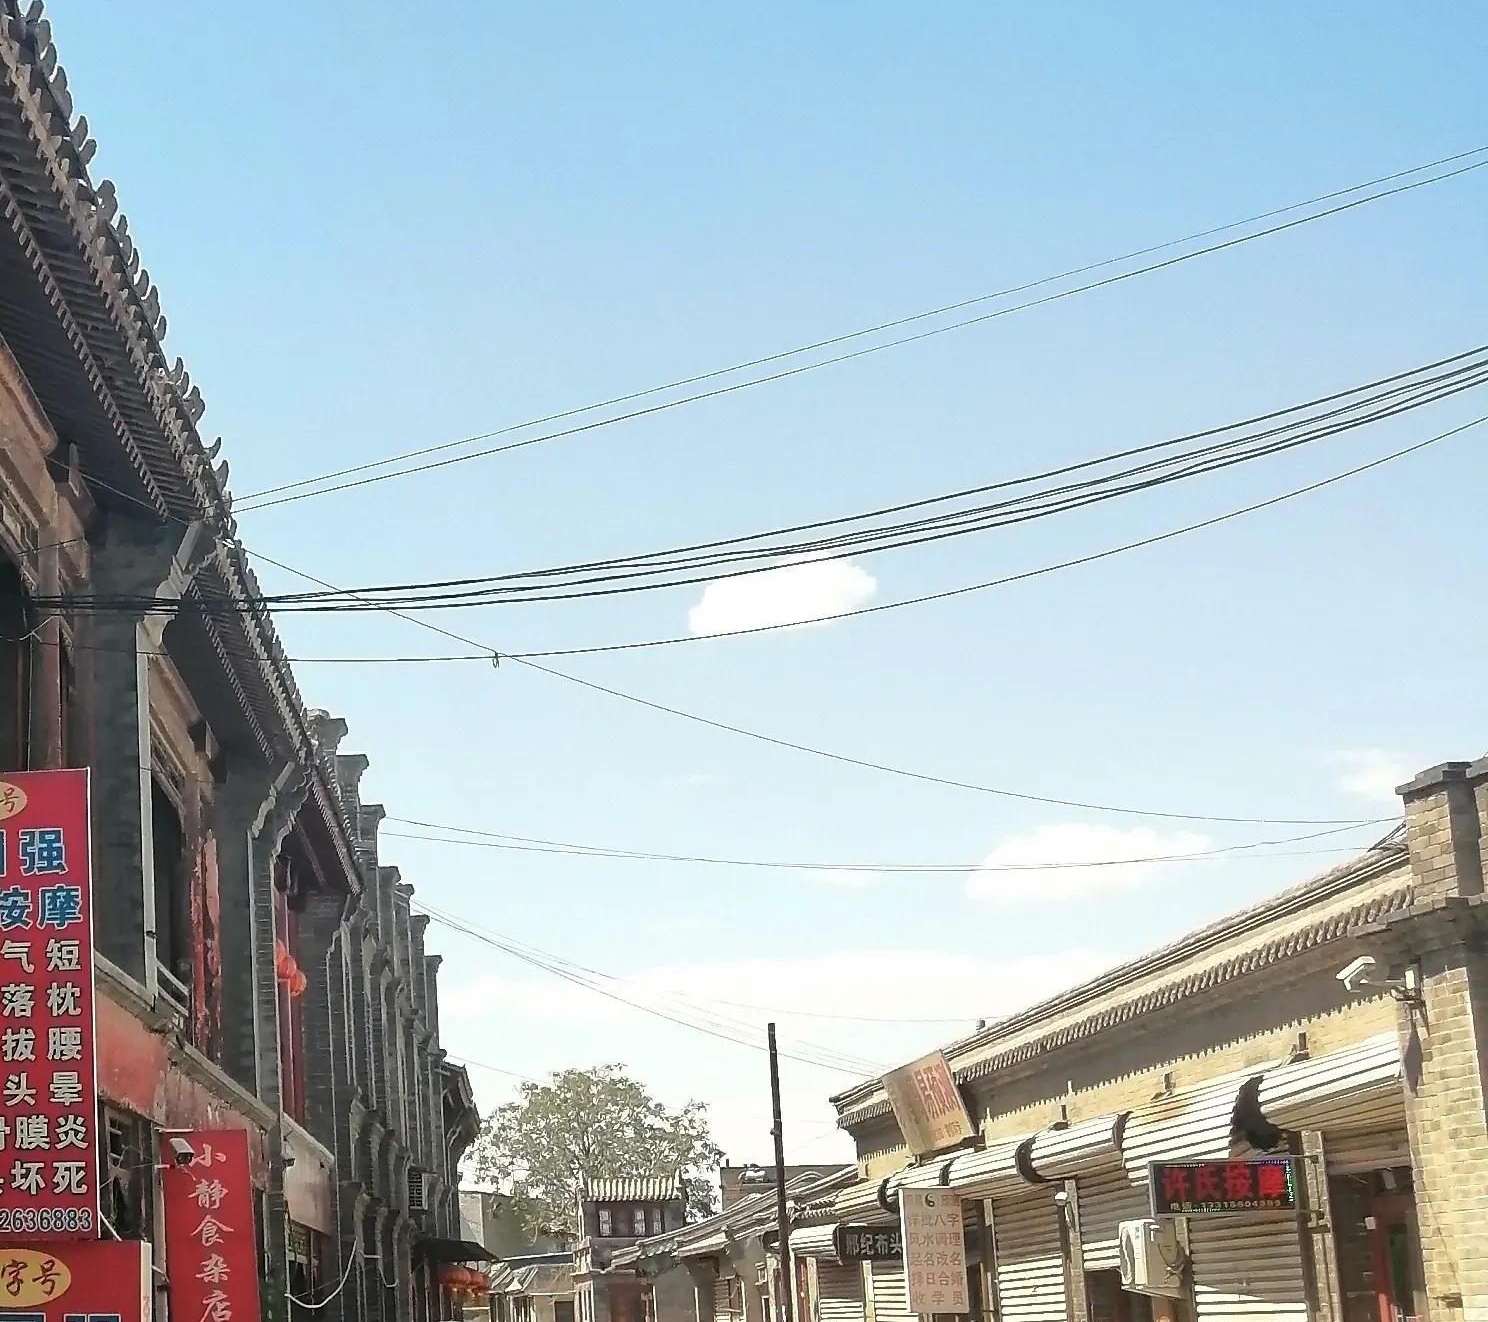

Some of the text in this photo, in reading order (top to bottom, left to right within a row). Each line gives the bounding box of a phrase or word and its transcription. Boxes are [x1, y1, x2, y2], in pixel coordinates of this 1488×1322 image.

[0, 939, 81, 973] 气短
[0, 981, 82, 1018] 落枕
[1, 1027, 82, 1062] 拔腰
[2, 1071, 83, 1107] 头晕
[1162, 1162, 1286, 1201] 许氏按摩
